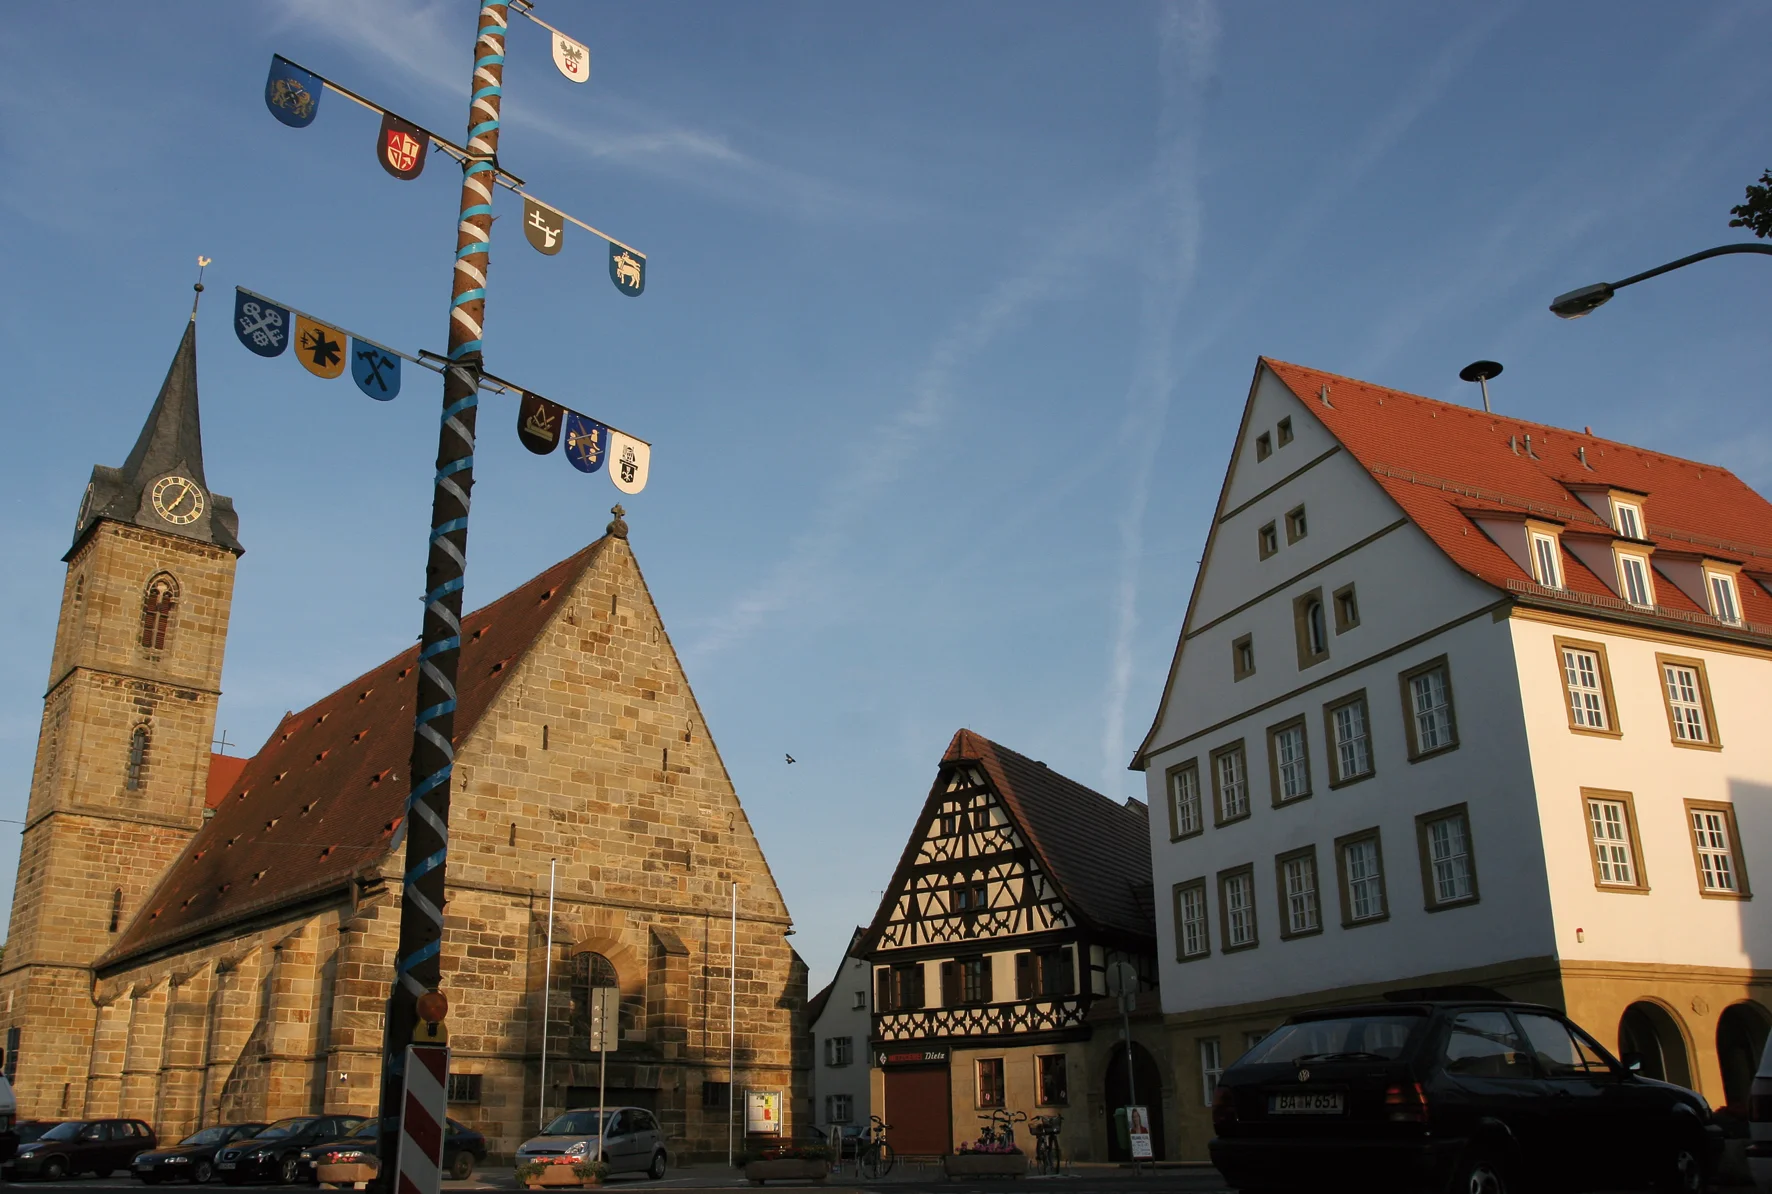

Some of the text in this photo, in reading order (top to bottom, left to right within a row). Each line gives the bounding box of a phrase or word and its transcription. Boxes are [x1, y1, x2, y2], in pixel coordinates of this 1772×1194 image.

[925, 1052, 945, 1060] Dietz
[1280, 1094, 1296, 1109] BA
[1315, 1093, 1338, 1109] 651
